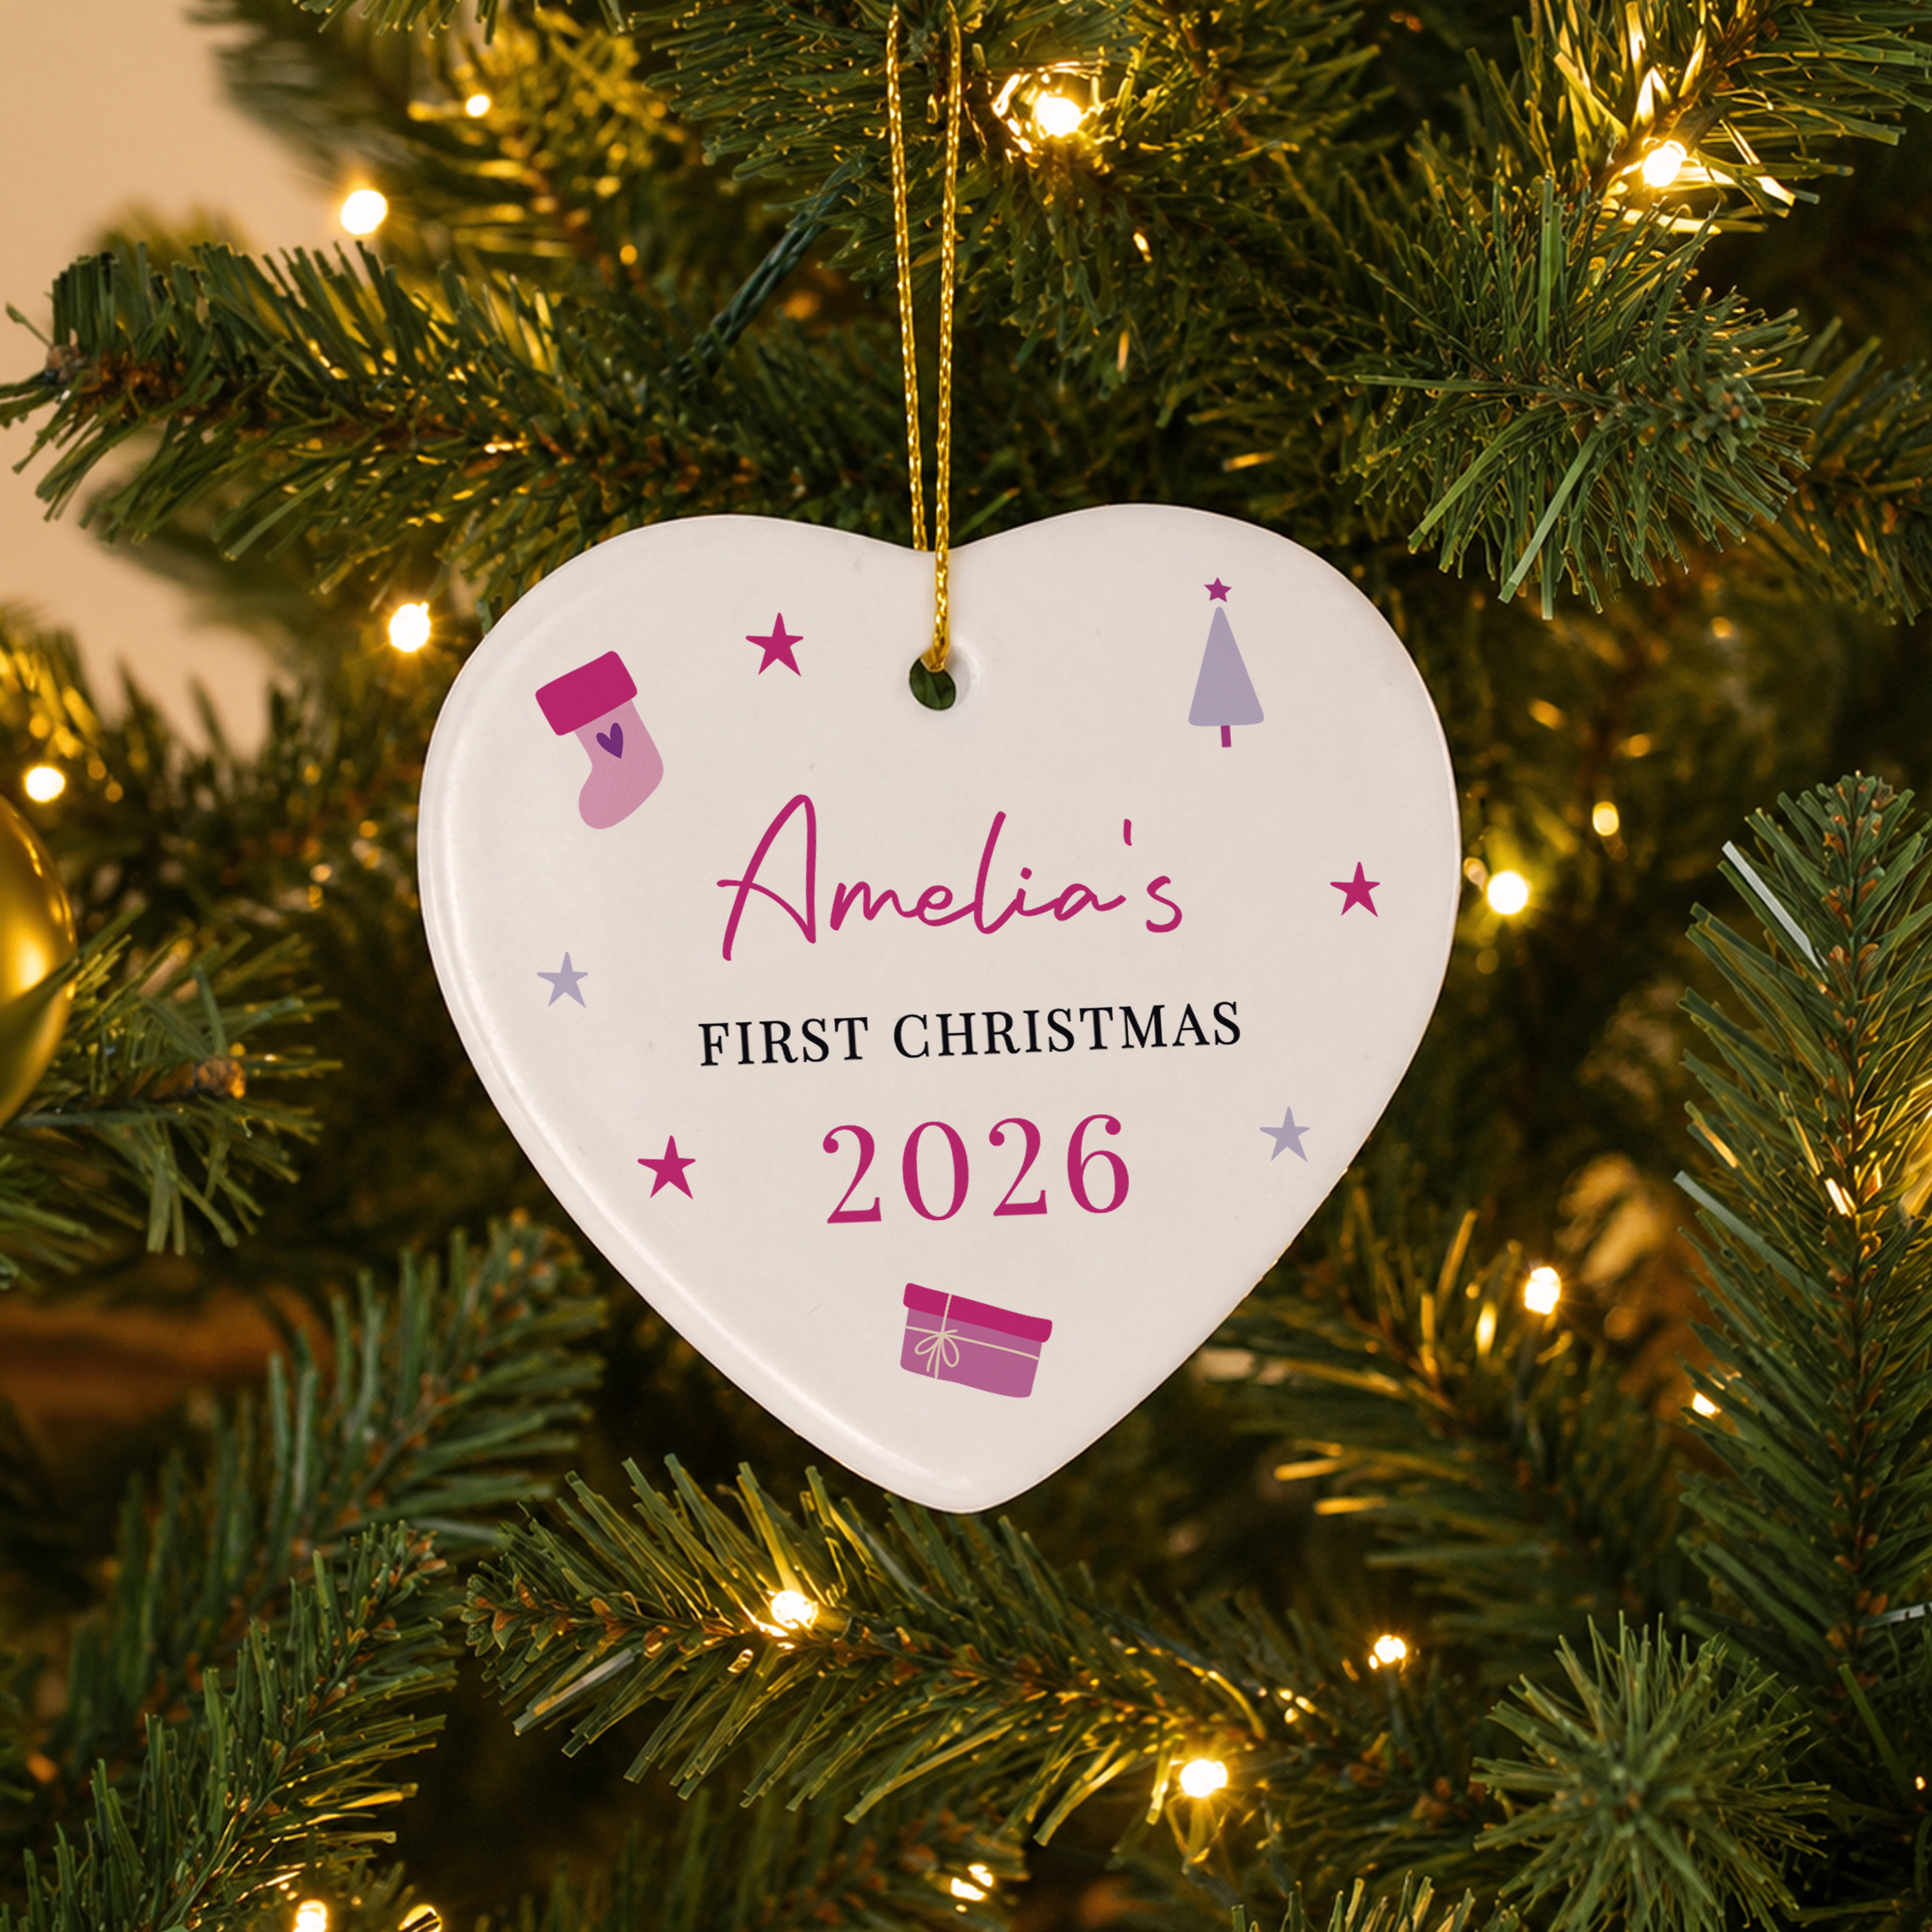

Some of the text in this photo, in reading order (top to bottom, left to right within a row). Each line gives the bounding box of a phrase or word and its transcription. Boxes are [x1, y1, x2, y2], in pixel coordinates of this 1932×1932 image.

[716, 793, 1183, 962] Amelia's
[698, 1001, 1241, 1066] FIRST CHRISTMAS
[822, 1114, 1130, 1224] 2026
